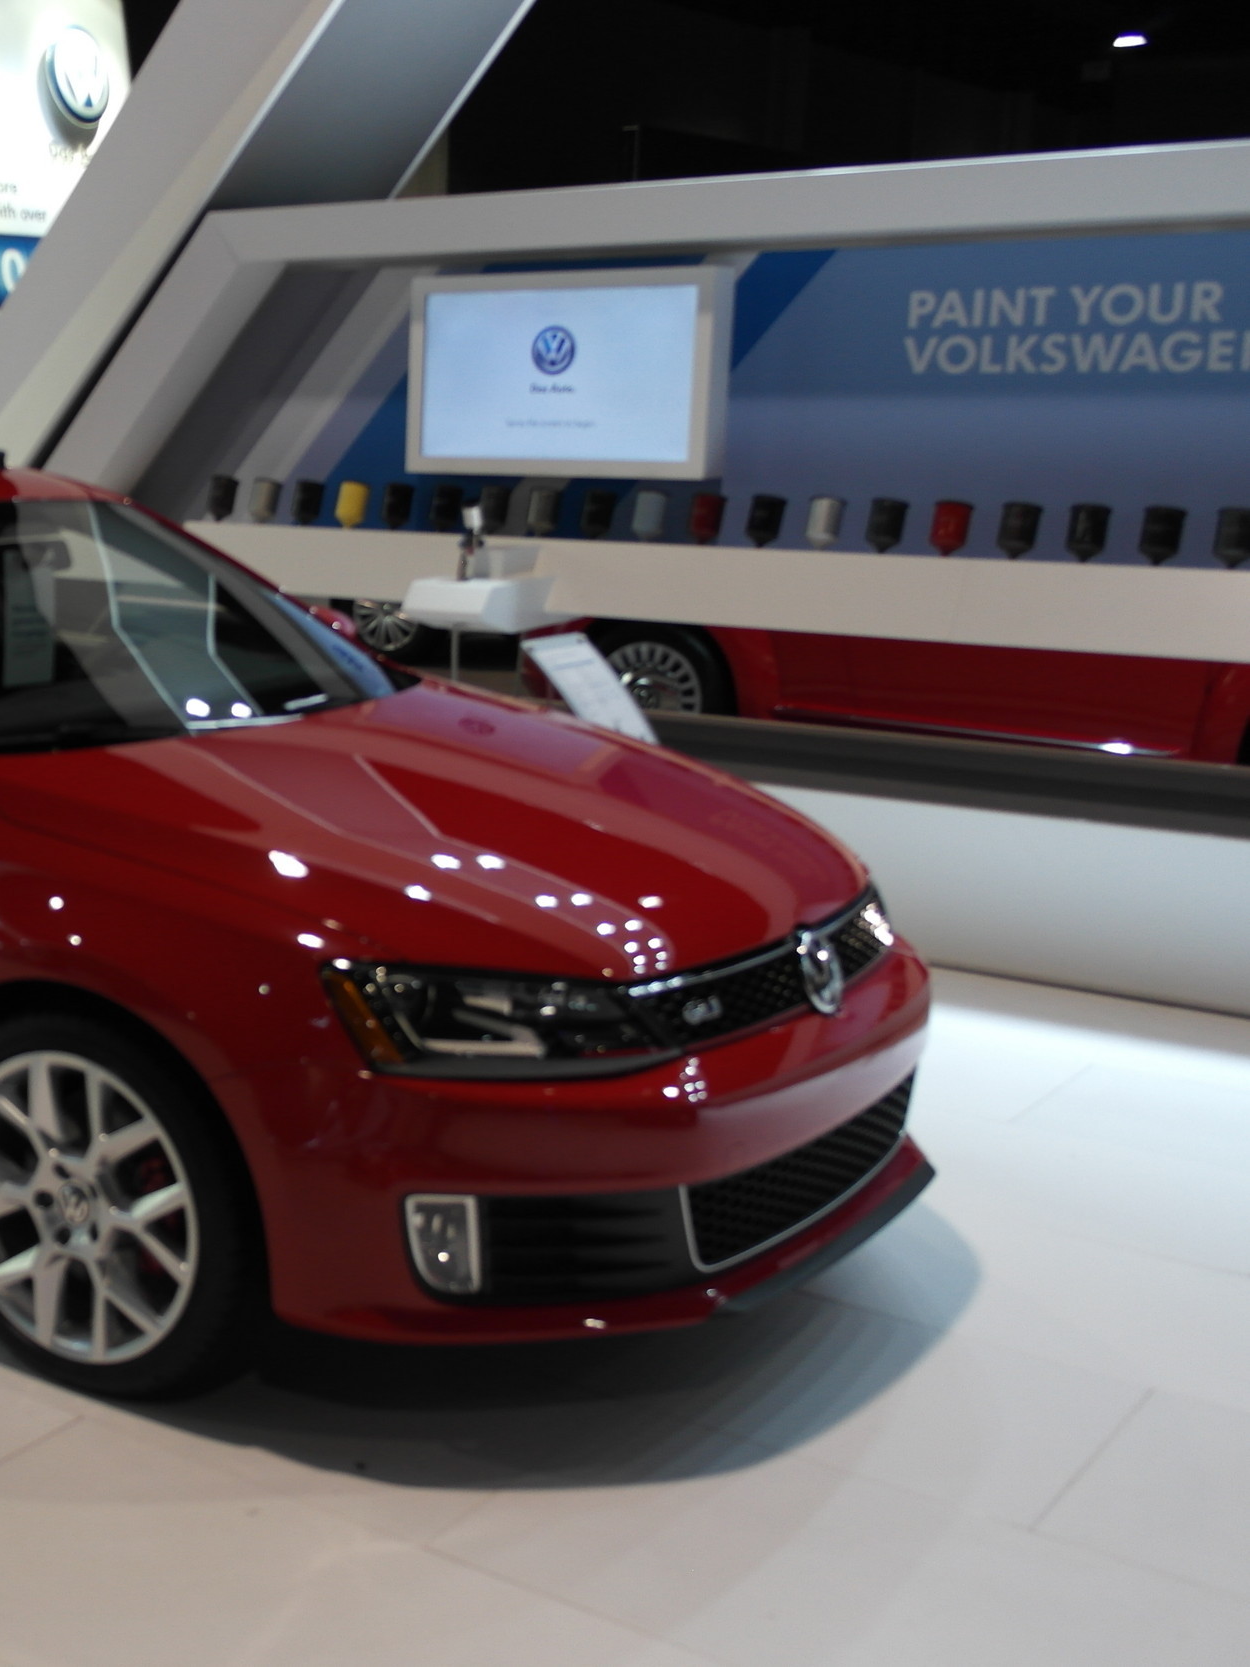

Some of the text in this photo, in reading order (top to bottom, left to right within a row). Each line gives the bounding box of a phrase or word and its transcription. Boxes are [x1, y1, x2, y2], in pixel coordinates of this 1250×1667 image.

[20, 208, 47, 222] over
[907, 281, 1224, 329] PAINT YOUR
